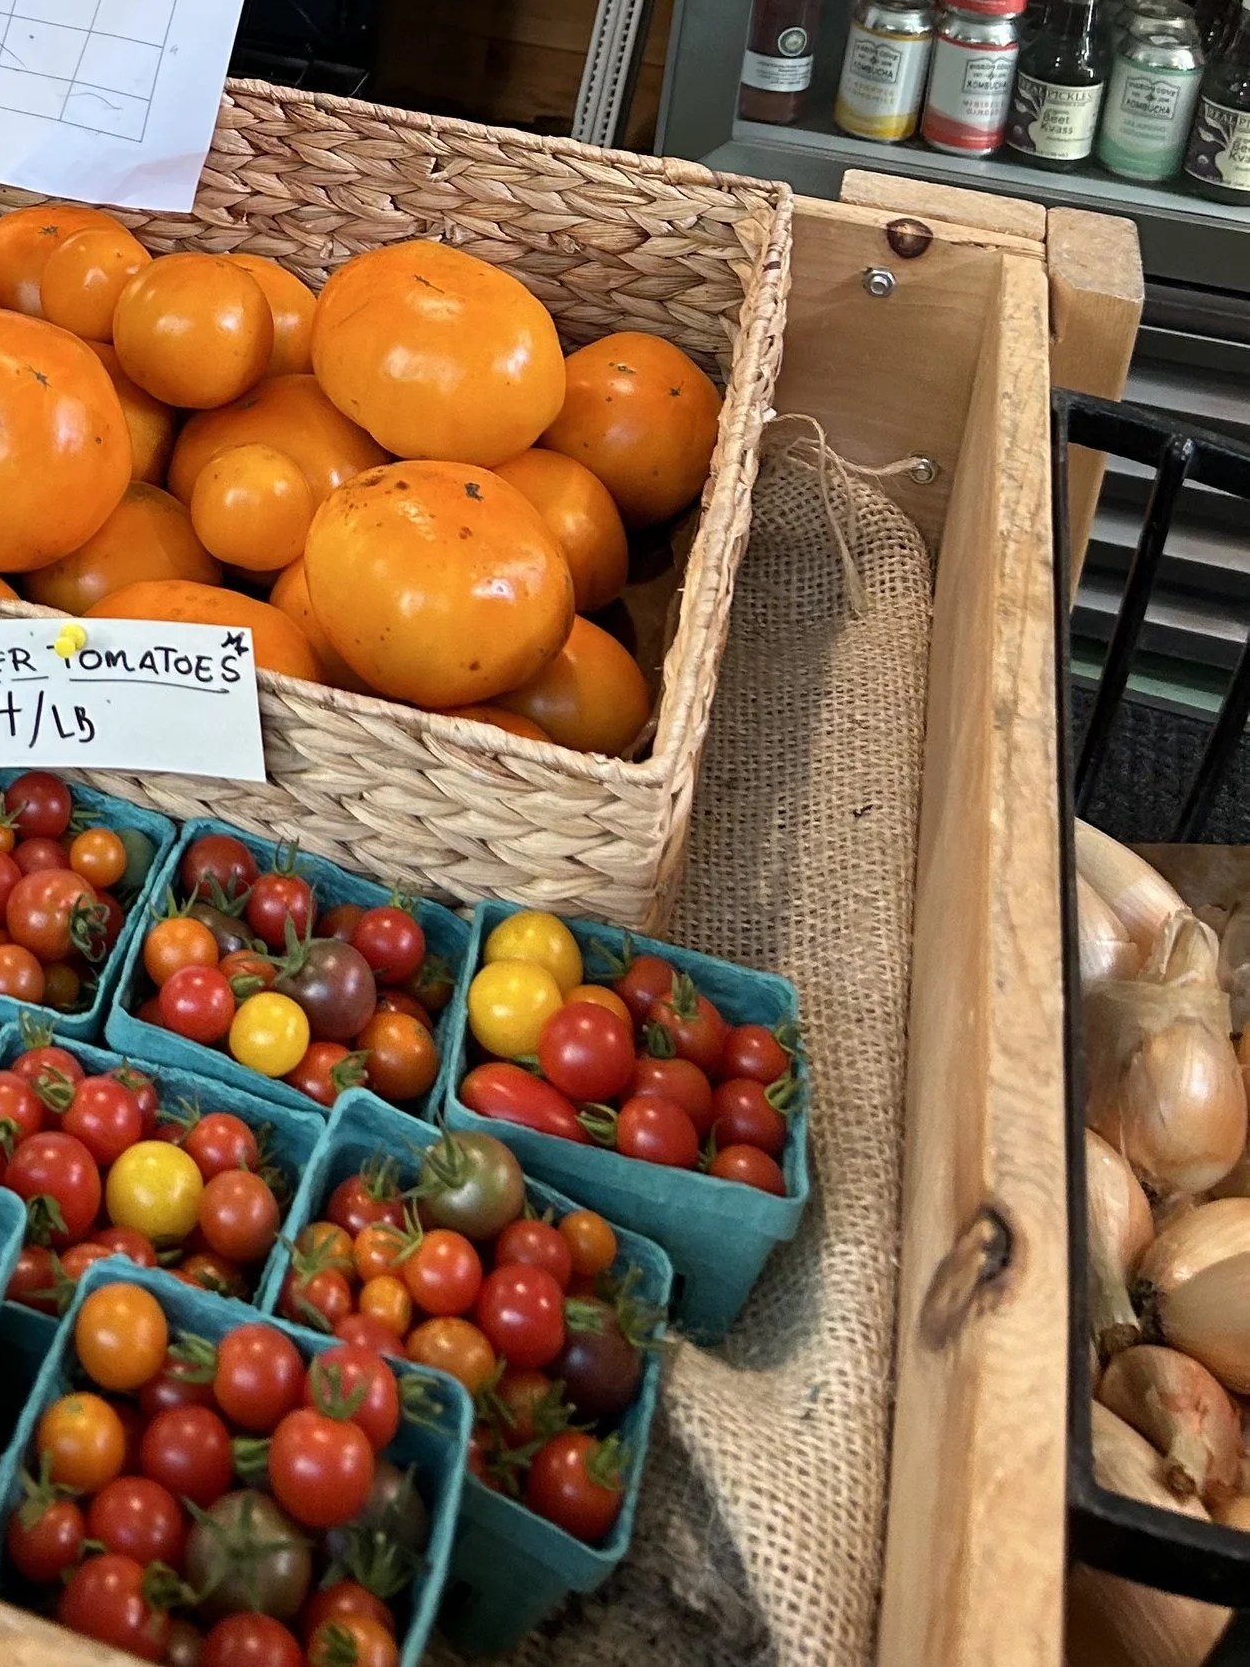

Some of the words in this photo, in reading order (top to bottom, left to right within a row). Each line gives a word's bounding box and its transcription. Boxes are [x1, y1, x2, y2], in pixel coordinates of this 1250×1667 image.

[1047, 89, 1093, 102] PICKLES
[1125, 98, 1171, 114] KOMBUCHA
[1043, 113, 1071, 125] Beet
[1040, 121, 1074, 135] Kvass
